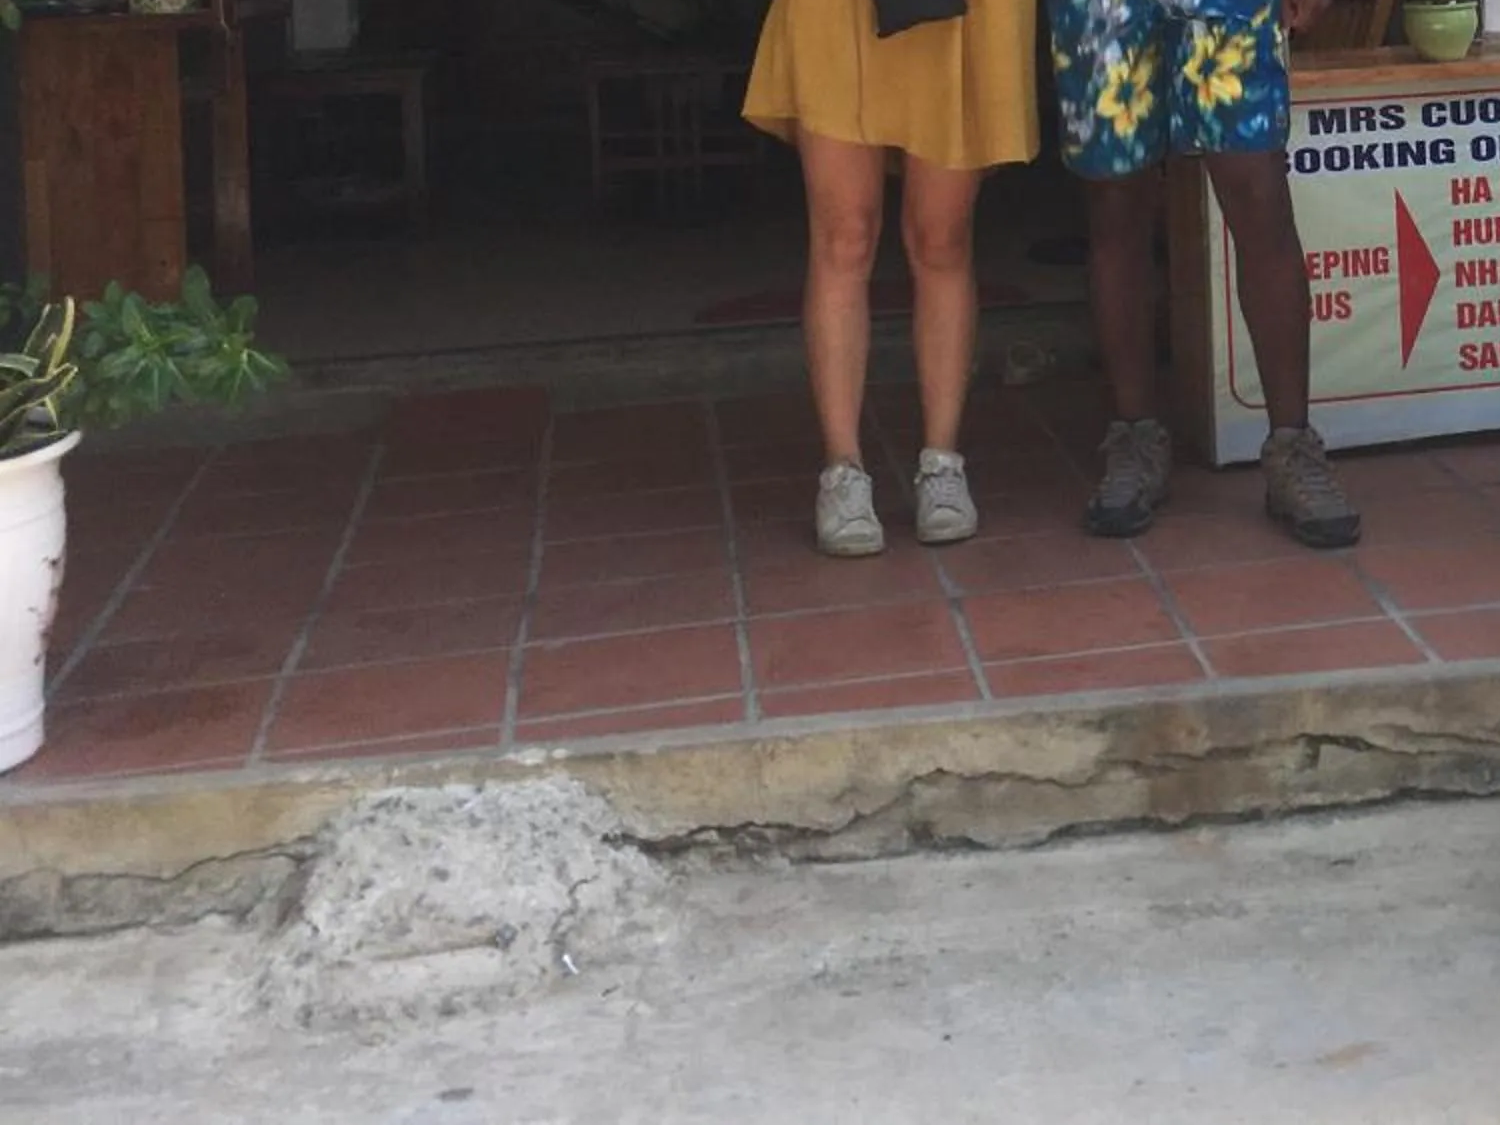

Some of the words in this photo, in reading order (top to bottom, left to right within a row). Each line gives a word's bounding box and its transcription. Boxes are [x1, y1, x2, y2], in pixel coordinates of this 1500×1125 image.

[1308, 104, 1406, 136] MRS
[1450, 176, 1493, 206] HA
[1311, 291, 1353, 323] US
